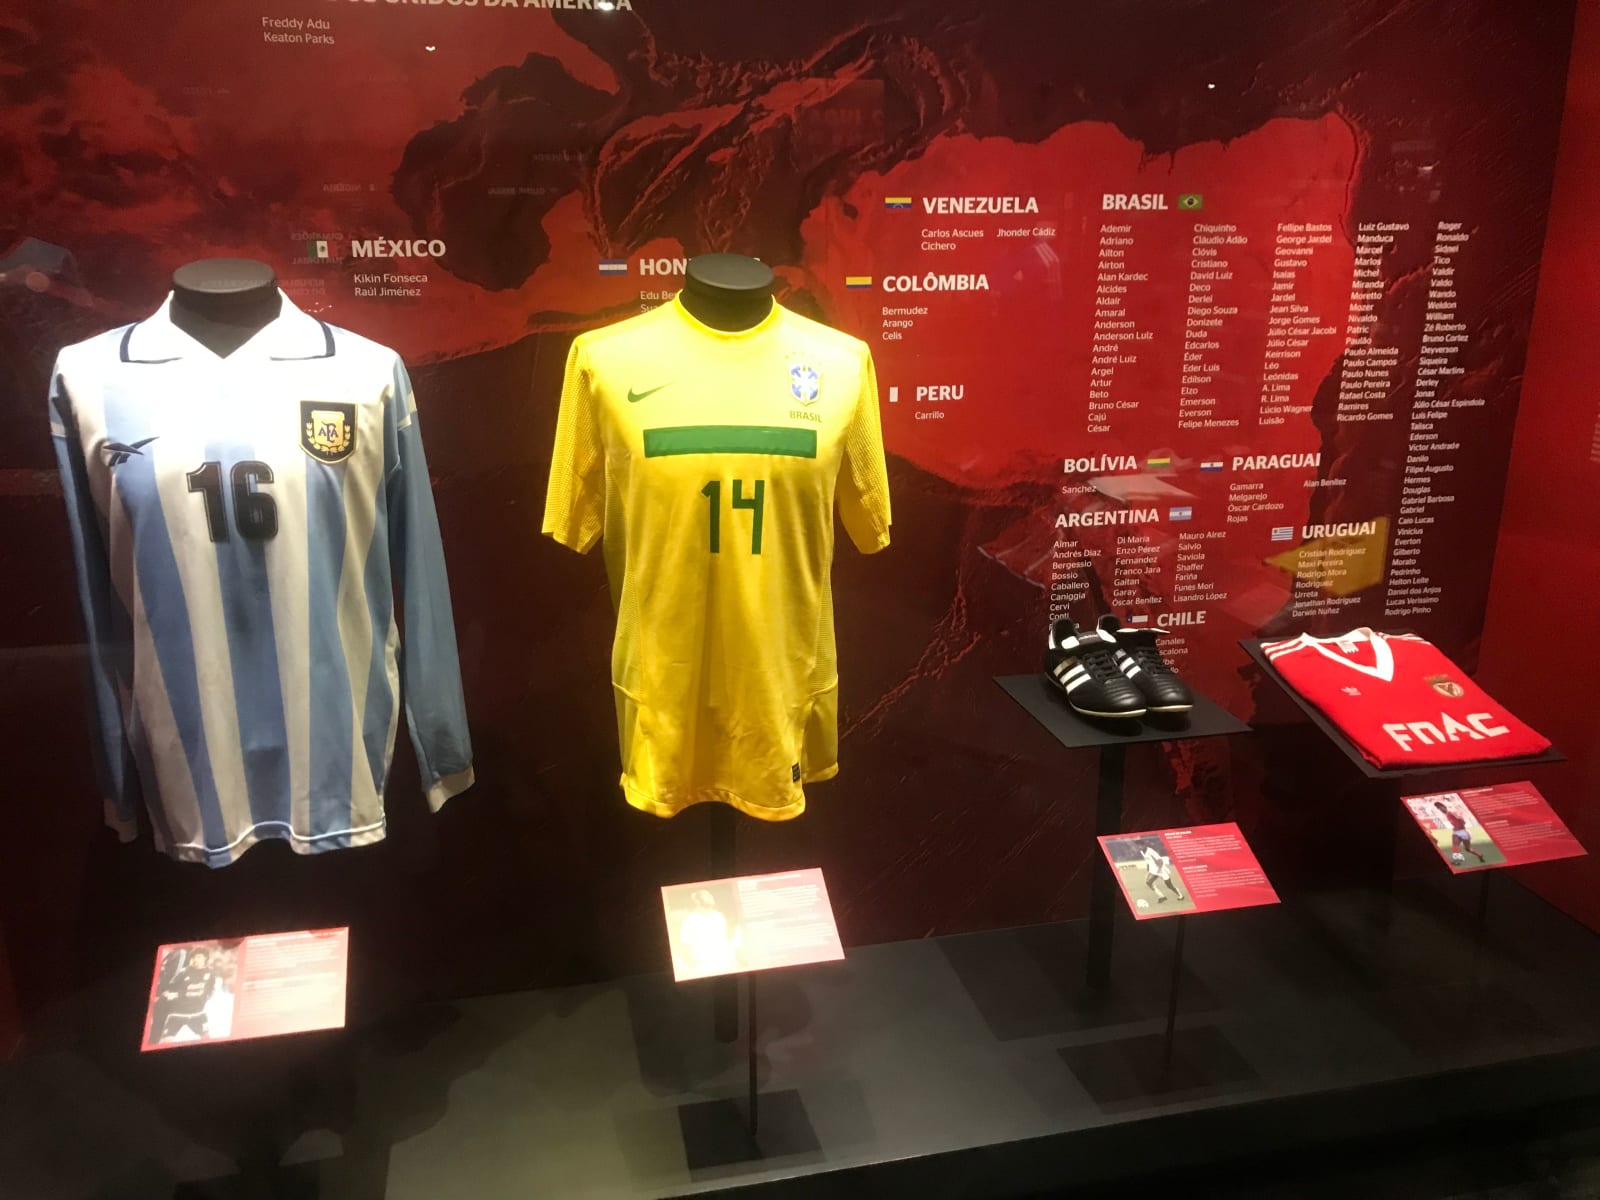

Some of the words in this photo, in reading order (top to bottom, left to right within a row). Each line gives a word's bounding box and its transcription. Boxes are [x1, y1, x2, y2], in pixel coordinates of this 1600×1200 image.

[262, 16, 303, 30] Freddy
[306, 18, 331, 30] Adu
[263, 32, 303, 44] Keaton
[305, 32, 335, 45] Parks
[922, 197, 1039, 214] VENEZUELA
[1102, 194, 1168, 210] BRASIL
[921, 229, 951, 238] Carlos
[952, 228, 984, 238] Ascues
[996, 228, 1031, 238] Jhonder
[1032, 227, 1056, 237] Cádiz
[1100, 224, 1132, 233] Ademir
[1194, 224, 1237, 233] Chiquinho
[1100, 236, 1134, 245] Adriano
[1192, 236, 1225, 244] Cláudio
[1225, 236, 1248, 244] Adão
[351, 237, 446, 259] MÉXICO
[921, 241, 957, 251] Cichero
[1099, 249, 1124, 257] Ailton
[1098, 261, 1125, 269] Airton
[1191, 259, 1228, 268] Cristiano
[353, 272, 380, 285] Kikin
[382, 272, 429, 284] Fonseca
[1097, 273, 1117, 281] Alan
[1118, 272, 1149, 281] Kardec
[1190, 272, 1214, 280] David
[1215, 271, 1233, 280] Luiz
[882, 272, 989, 292] COLÔMBIA
[354, 286, 377, 298] Raúl
[378, 286, 422, 298] Jiménez
[1096, 285, 1127, 293] Alcides
[1096, 297, 1121, 305] Aldair
[882, 306, 929, 315] Bermudez
[1095, 308, 1126, 316] Amaral
[1187, 307, 1212, 315] Diego
[1213, 306, 1238, 315] Souza
[882, 319, 914, 330] Arango
[1094, 320, 1135, 329] Anderson
[882, 332, 903, 341] Celis
[1093, 333, 1135, 341] Anderson
[1135, 332, 1154, 340] Luiz
[1185, 330, 1207, 338] Duda
[1092, 344, 1119, 352] André
[1092, 355, 1118, 364] André
[1119, 355, 1137, 363] Luiz
[1183, 352, 1202, 361] Éder
[1091, 367, 1114, 377] Argel
[1090, 379, 1112, 387] Artur
[1181, 375, 1211, 383] Edilson
[916, 385, 964, 402] PERU
[1089, 391, 1109, 399] Beto
[1088, 402, 1114, 410] Bruno
[1116, 401, 1139, 409] César
[1180, 398, 1216, 406] Emerson
[789, 411, 823, 423] BRASIL
[914, 411, 945, 420] Carrillo
[1179, 409, 1212, 417] Everson
[1087, 424, 1111, 432] César
[1178, 420, 1203, 429] Felipe
[1204, 419, 1240, 427] Menezes
[1063, 454, 1138, 473] BOLÍVIA
[1232, 453, 1321, 471] PARAGUAI
[1062, 484, 1097, 494] Sanchez
[1230, 482, 1264, 491] Gamarra
[1229, 493, 1268, 502] Melgarejo
[1227, 503, 1250, 512] Óscar
[1251, 502, 1285, 511] Cardozo
[1055, 508, 1160, 528] ARGENTINA
[1227, 514, 1248, 524] Rojas
[1301, 521, 1376, 539] URUGUAI
[1179, 532, 1205, 540] Mauro
[1053, 540, 1079, 548] Aimar
[1178, 542, 1202, 551] Salvio
[1116, 547, 1137, 555] Enzo
[1137, 545, 1161, 554] Pérez
[1177, 552, 1205, 561] Saviola
[1052, 559, 1092, 571] Bergessio
[1176, 563, 1204, 571] Shaffer
[1114, 568, 1143, 576] Franco
[1143, 566, 1161, 575] Jara
[1051, 572, 1079, 580] Bossio
[1175, 573, 1198, 581] Fariña
[1051, 582, 1090, 591] Caballero
[1050, 592, 1086, 602] Caniggia
[1113, 588, 1137, 598] Garay
[1173, 593, 1205, 602] Lisandro
[1205, 592, 1228, 602] López
[1049, 603, 1070, 611] Cervi
[1156, 611, 1207, 627] CHILE
[1159, 647, 1189, 656] scalona
